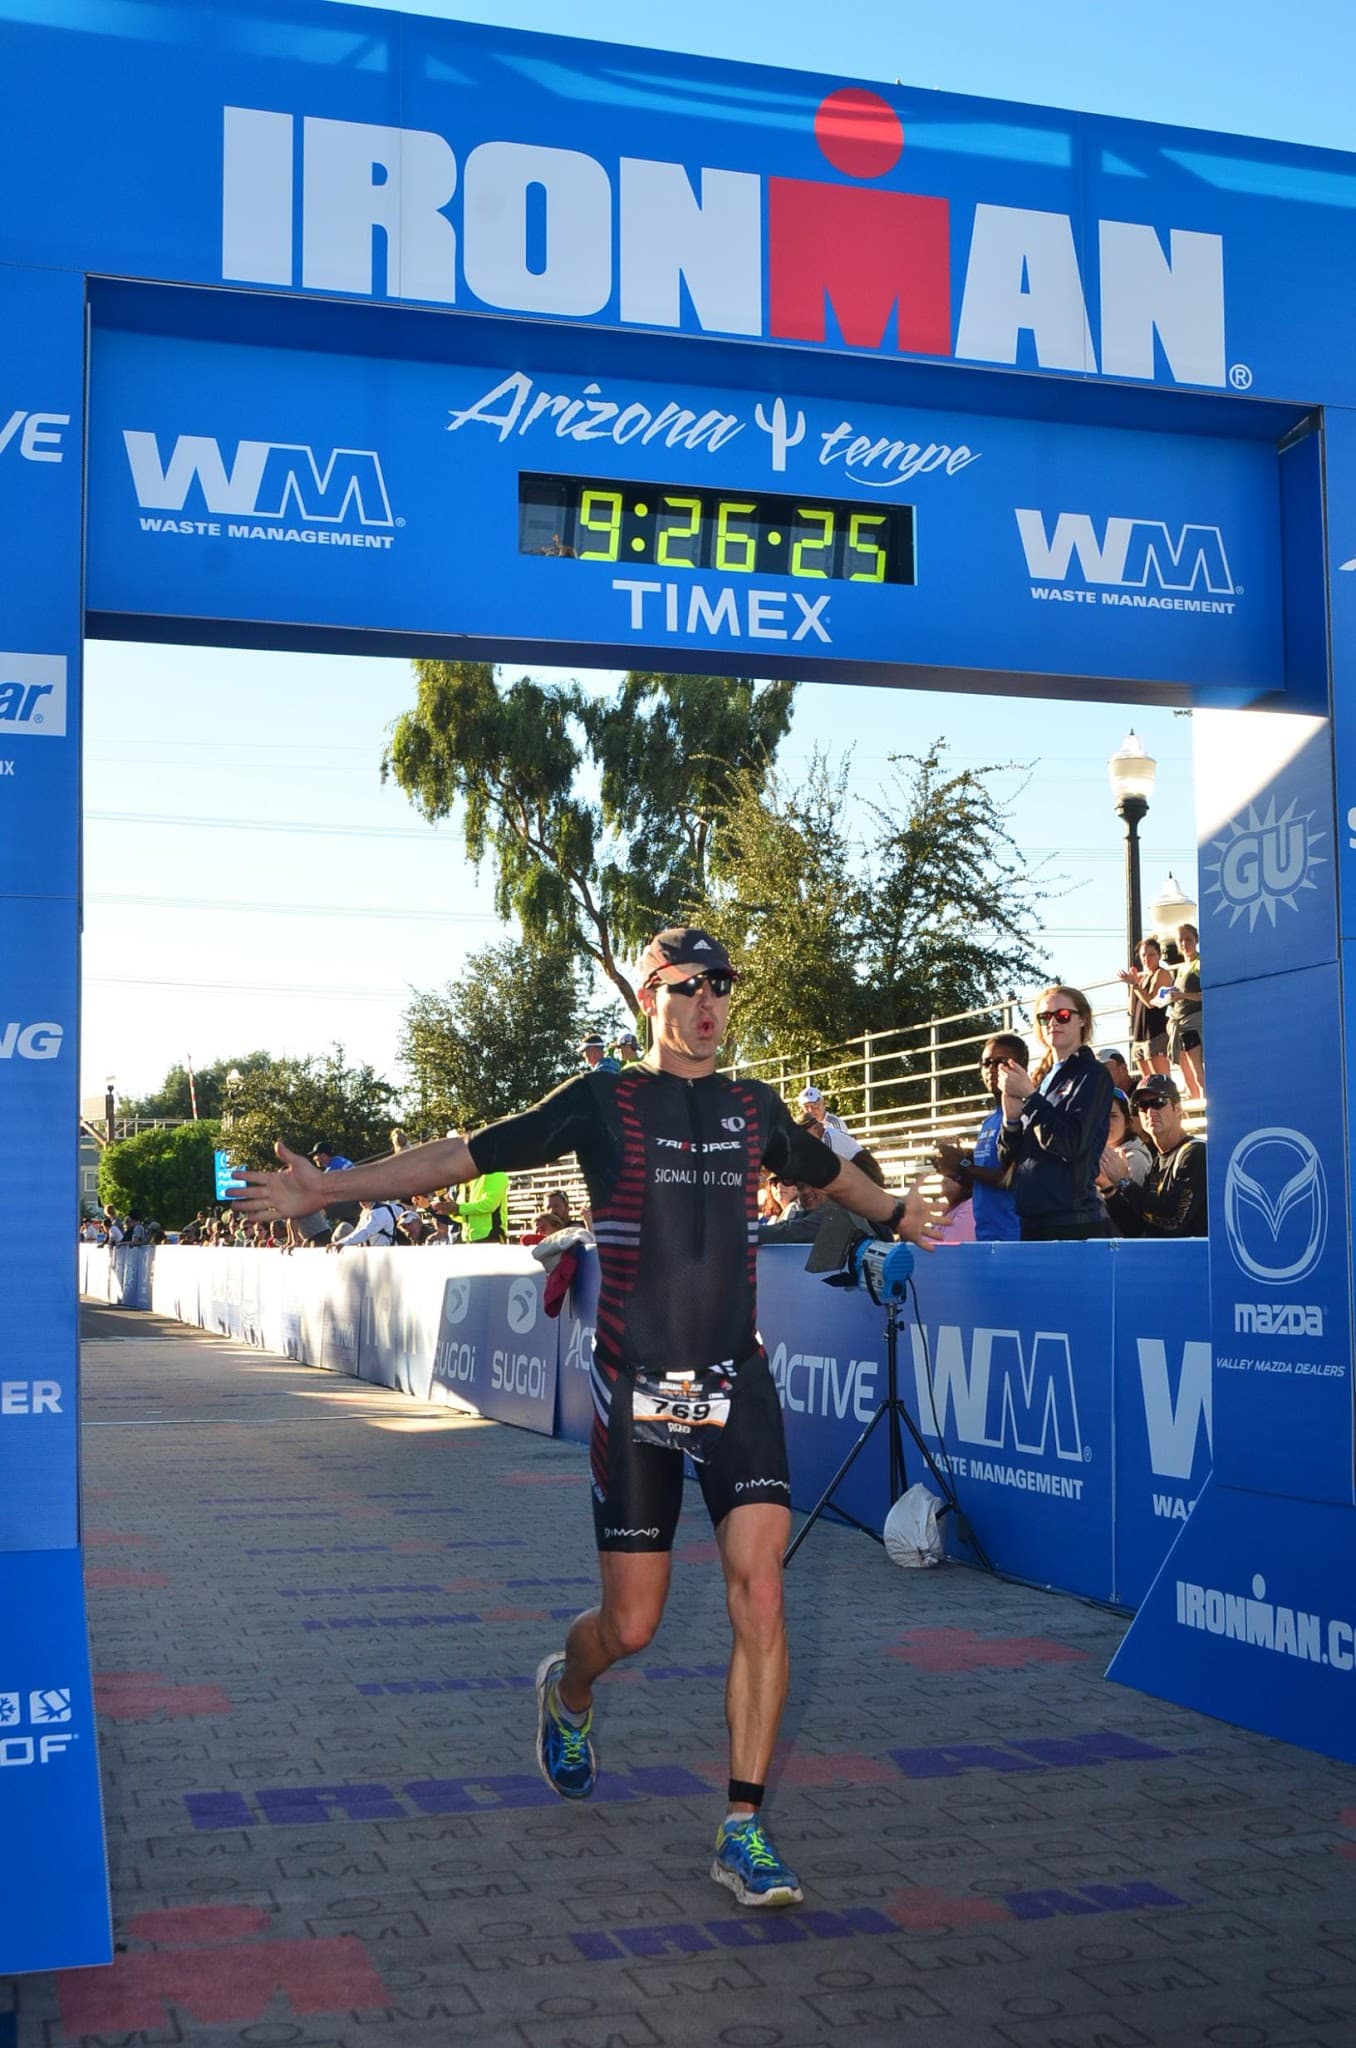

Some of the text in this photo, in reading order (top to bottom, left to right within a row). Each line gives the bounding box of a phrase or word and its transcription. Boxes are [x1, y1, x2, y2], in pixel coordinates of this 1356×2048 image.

[222, 88, 1226, 388] IRONMAN
[446, 371, 983, 488] Arizona tempe
[122, 430, 395, 527] WM
[138, 516, 395, 550] WASTE MANAGEMENT
[1014, 508, 1235, 595] WM
[612, 579, 833, 644] TIMEX
[1030, 586, 1236, 615] WASTE MANAGEMENT
[1222, 822, 1305, 901] GU
[768, 1342, 879, 1424] ACTIVE
[910, 1323, 1084, 1462] WM
[1216, 1357, 1346, 1378] VALLEY MAZDA DEALERS
[651, 1398, 712, 1422] 769
[970, 1459, 1084, 1501] MANAGEMENT
[1176, 1573, 1356, 1672] IRONMAN.C
